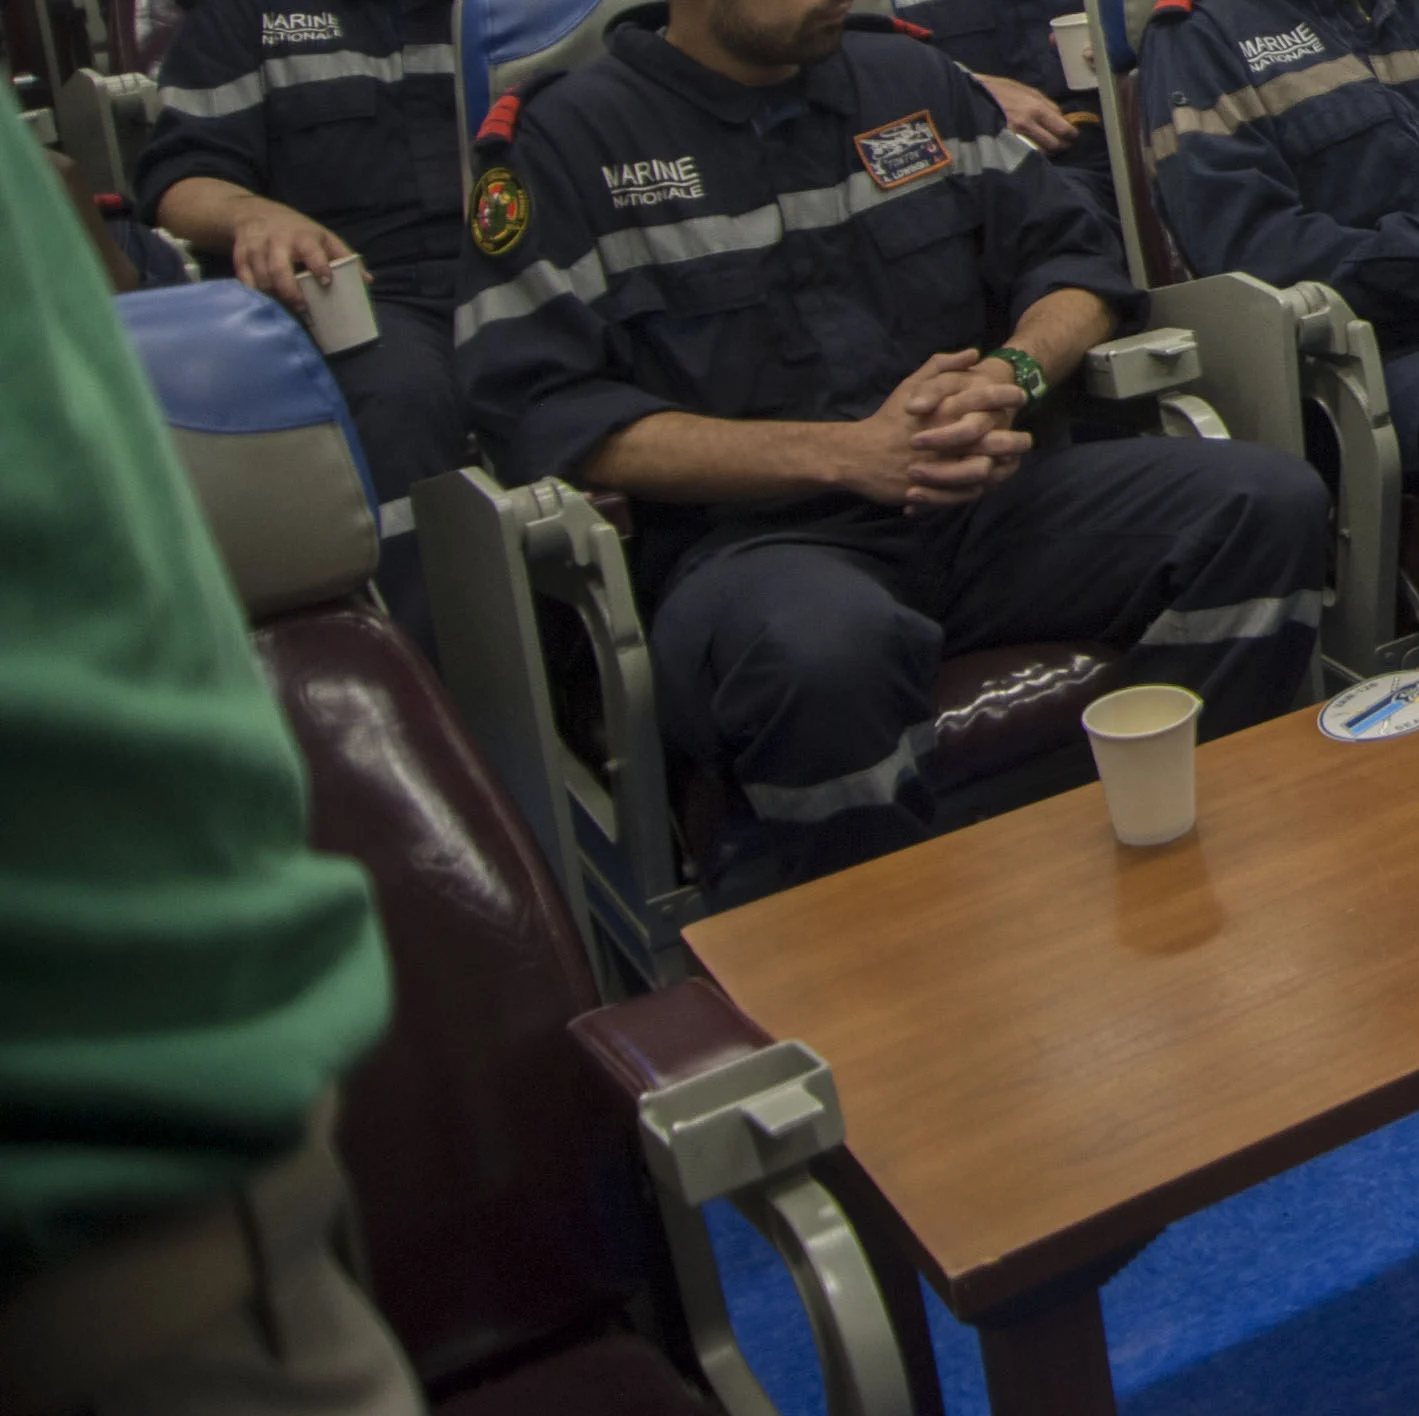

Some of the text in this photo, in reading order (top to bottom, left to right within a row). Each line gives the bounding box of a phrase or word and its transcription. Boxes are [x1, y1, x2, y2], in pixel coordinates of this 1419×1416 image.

[262, 28, 344, 46] NTIONALE
[1238, 22, 1317, 58] MARINE
[601, 156, 701, 189] MARINE
